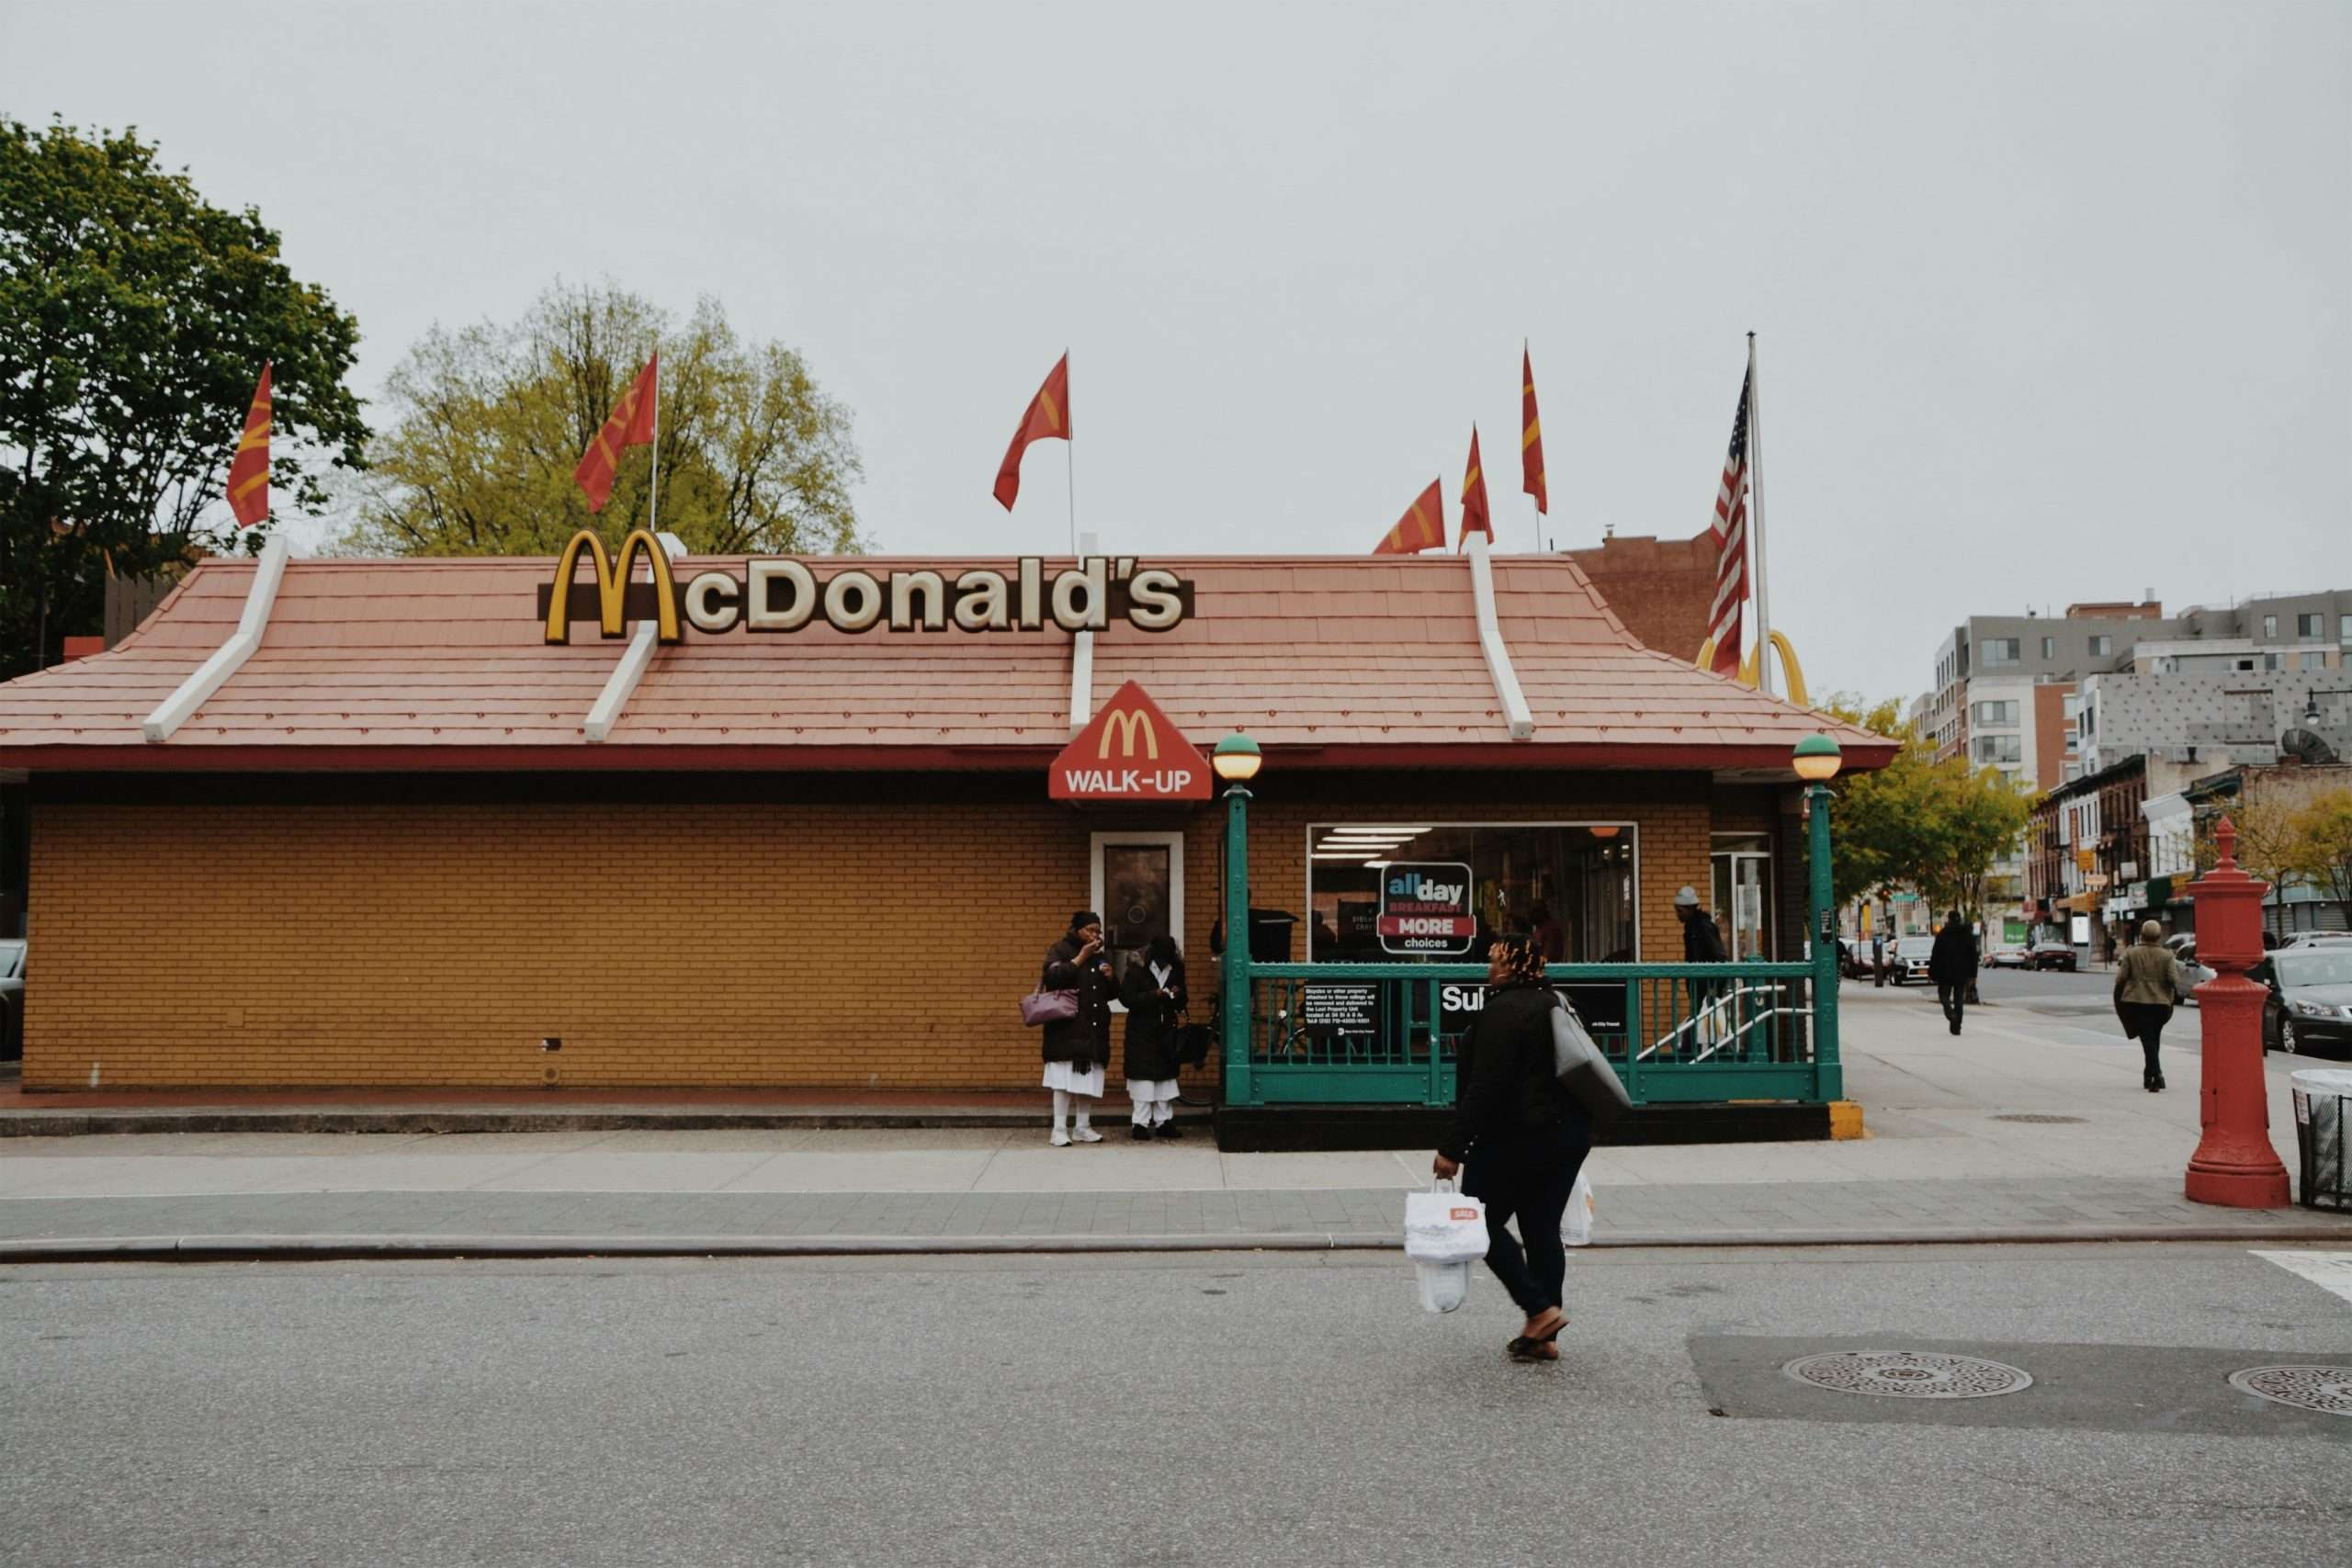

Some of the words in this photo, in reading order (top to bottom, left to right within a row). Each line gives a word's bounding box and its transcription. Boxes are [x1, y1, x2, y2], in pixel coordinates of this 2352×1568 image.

[545, 528, 1183, 644] McDonald's
[1065, 770, 1192, 793] WALK-UP
[1389, 902, 1463, 912] BREAKFAST
[1398, 918, 1453, 934] MORE
[1405, 937, 1448, 948] choices
